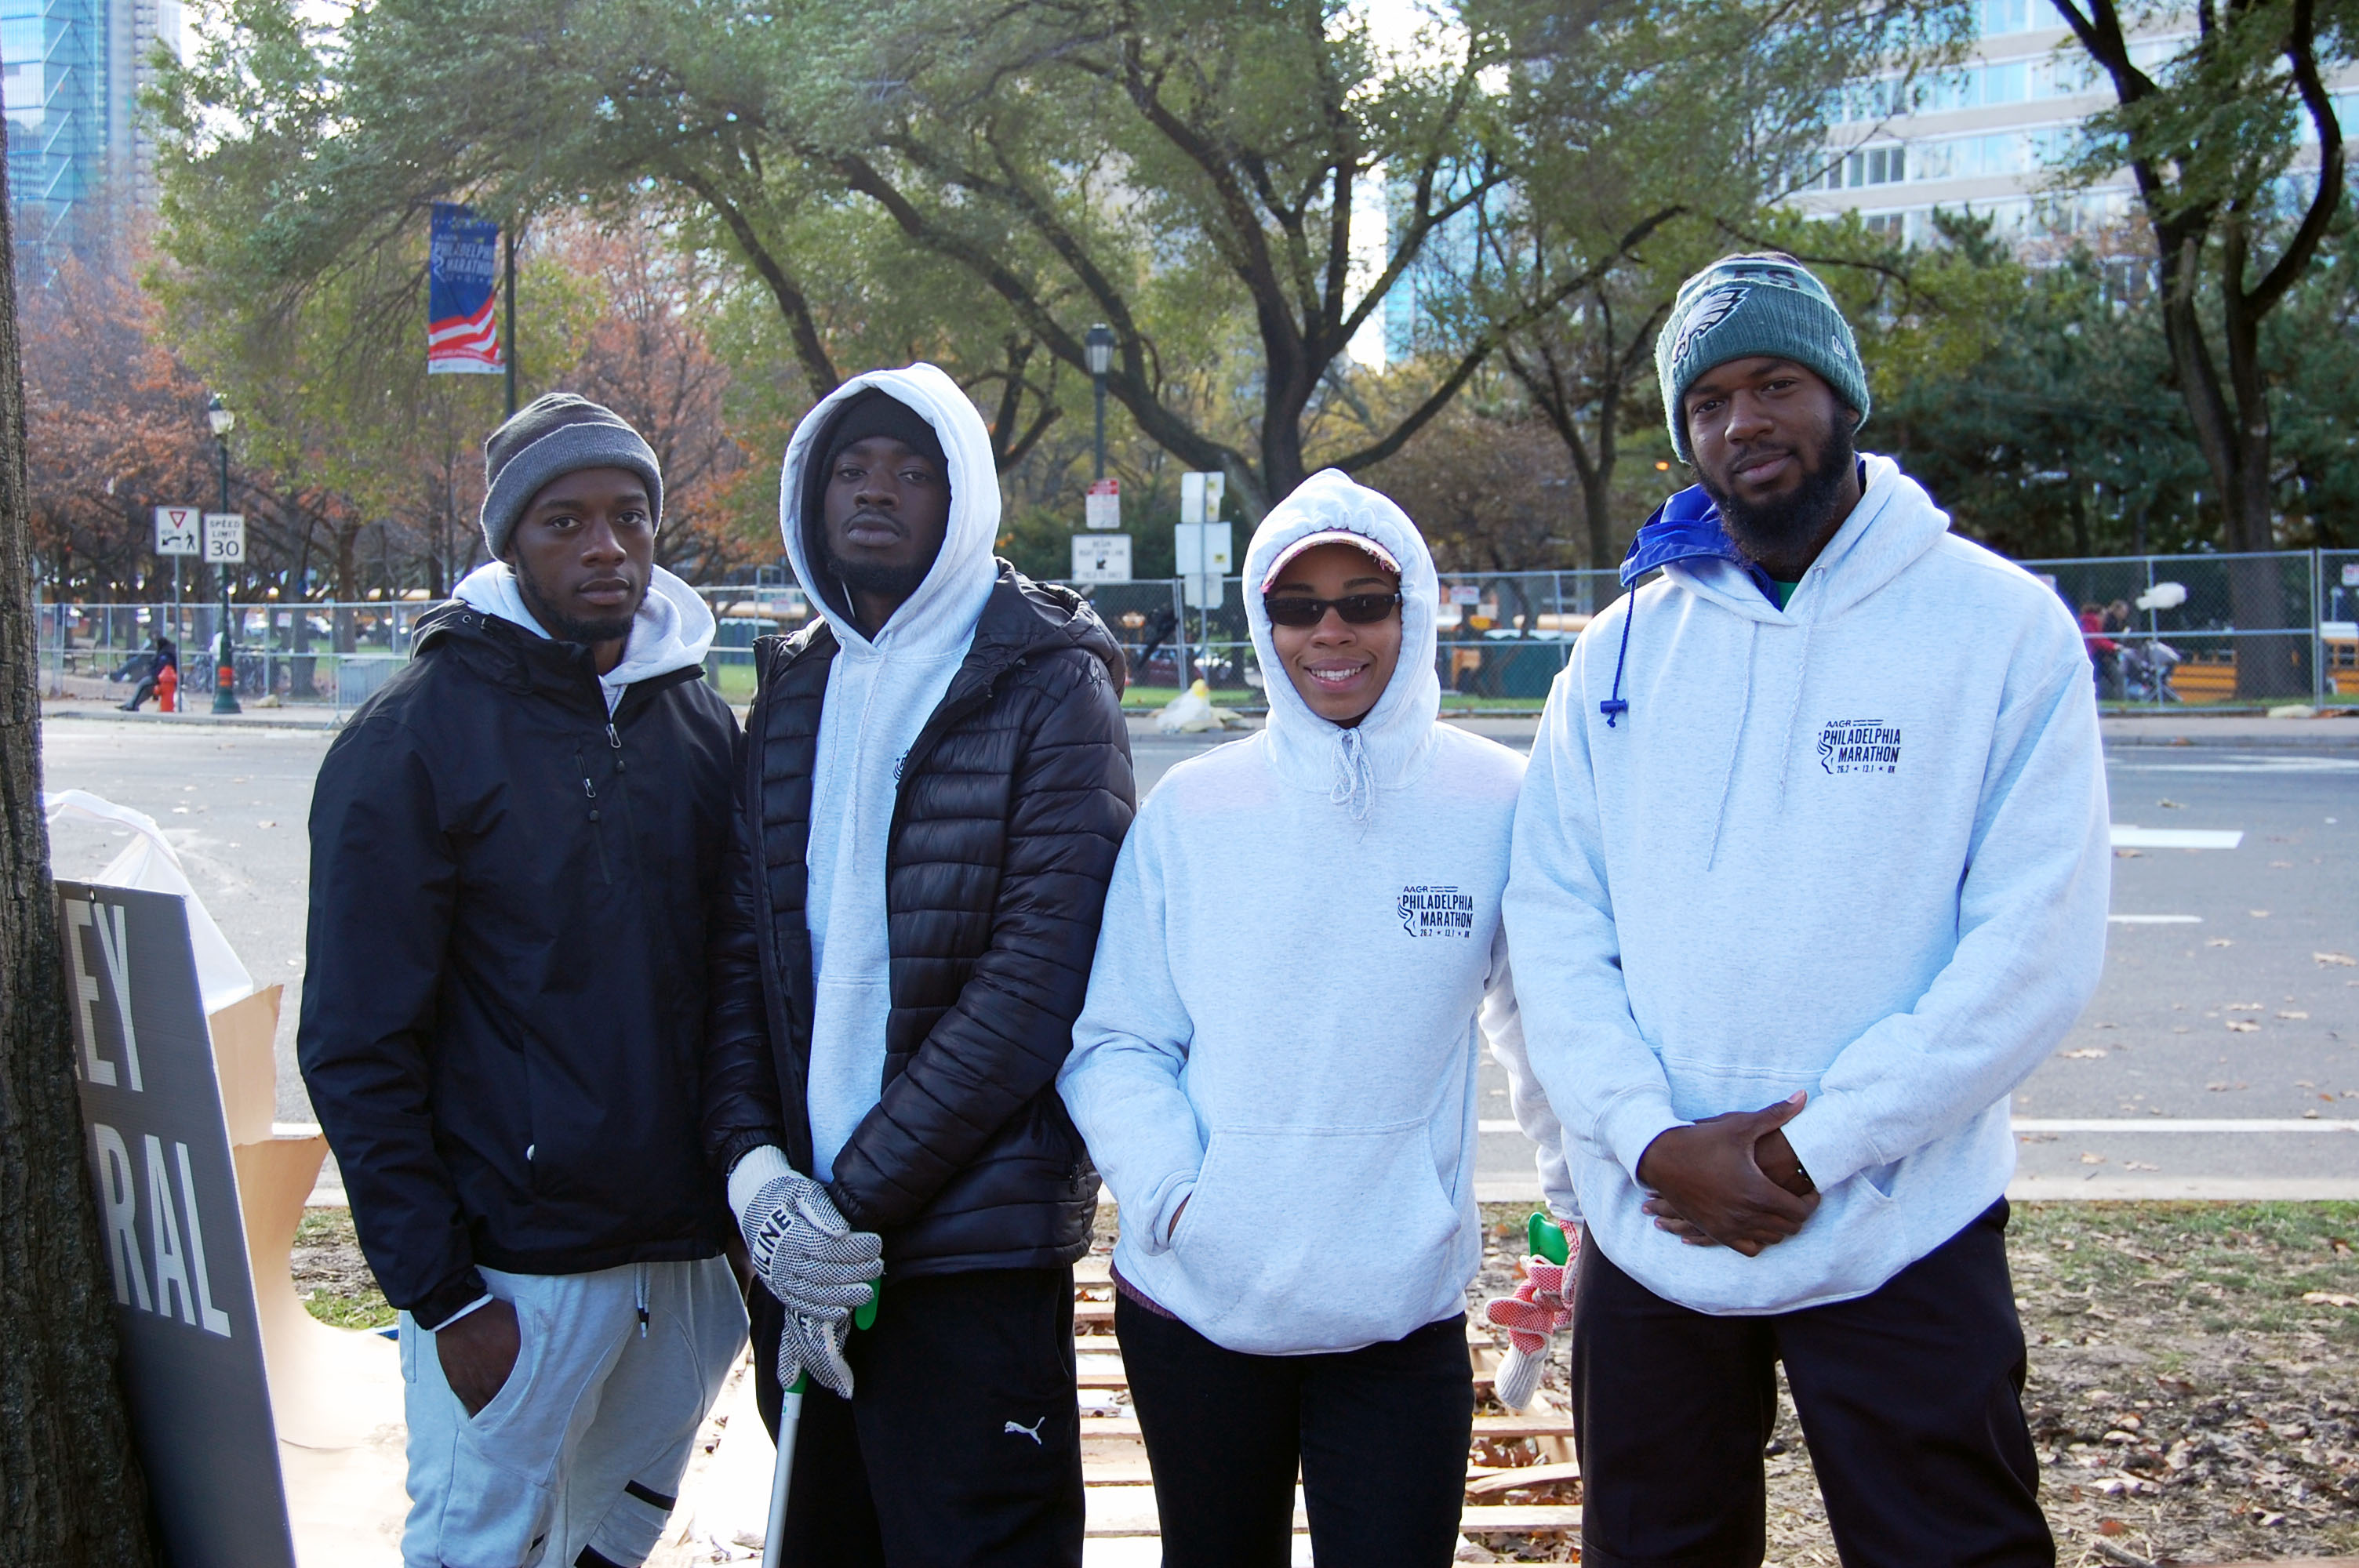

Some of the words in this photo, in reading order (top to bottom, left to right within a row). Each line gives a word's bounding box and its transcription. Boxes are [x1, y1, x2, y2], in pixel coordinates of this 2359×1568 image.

[434, 242, 495, 260] PHILADELPHI
[209, 519, 240, 528] SPEED
[211, 540, 239, 557] 30
[1823, 728, 1900, 745] PHILADELPHIA
[1838, 746, 1901, 763] MARATHON
[1402, 895, 1473, 911] PHILADELPHIA
[1420, 911, 1474, 928] MARATHON
[64, 898, 143, 1091] EY
[753, 1208, 792, 1276] ULINE
